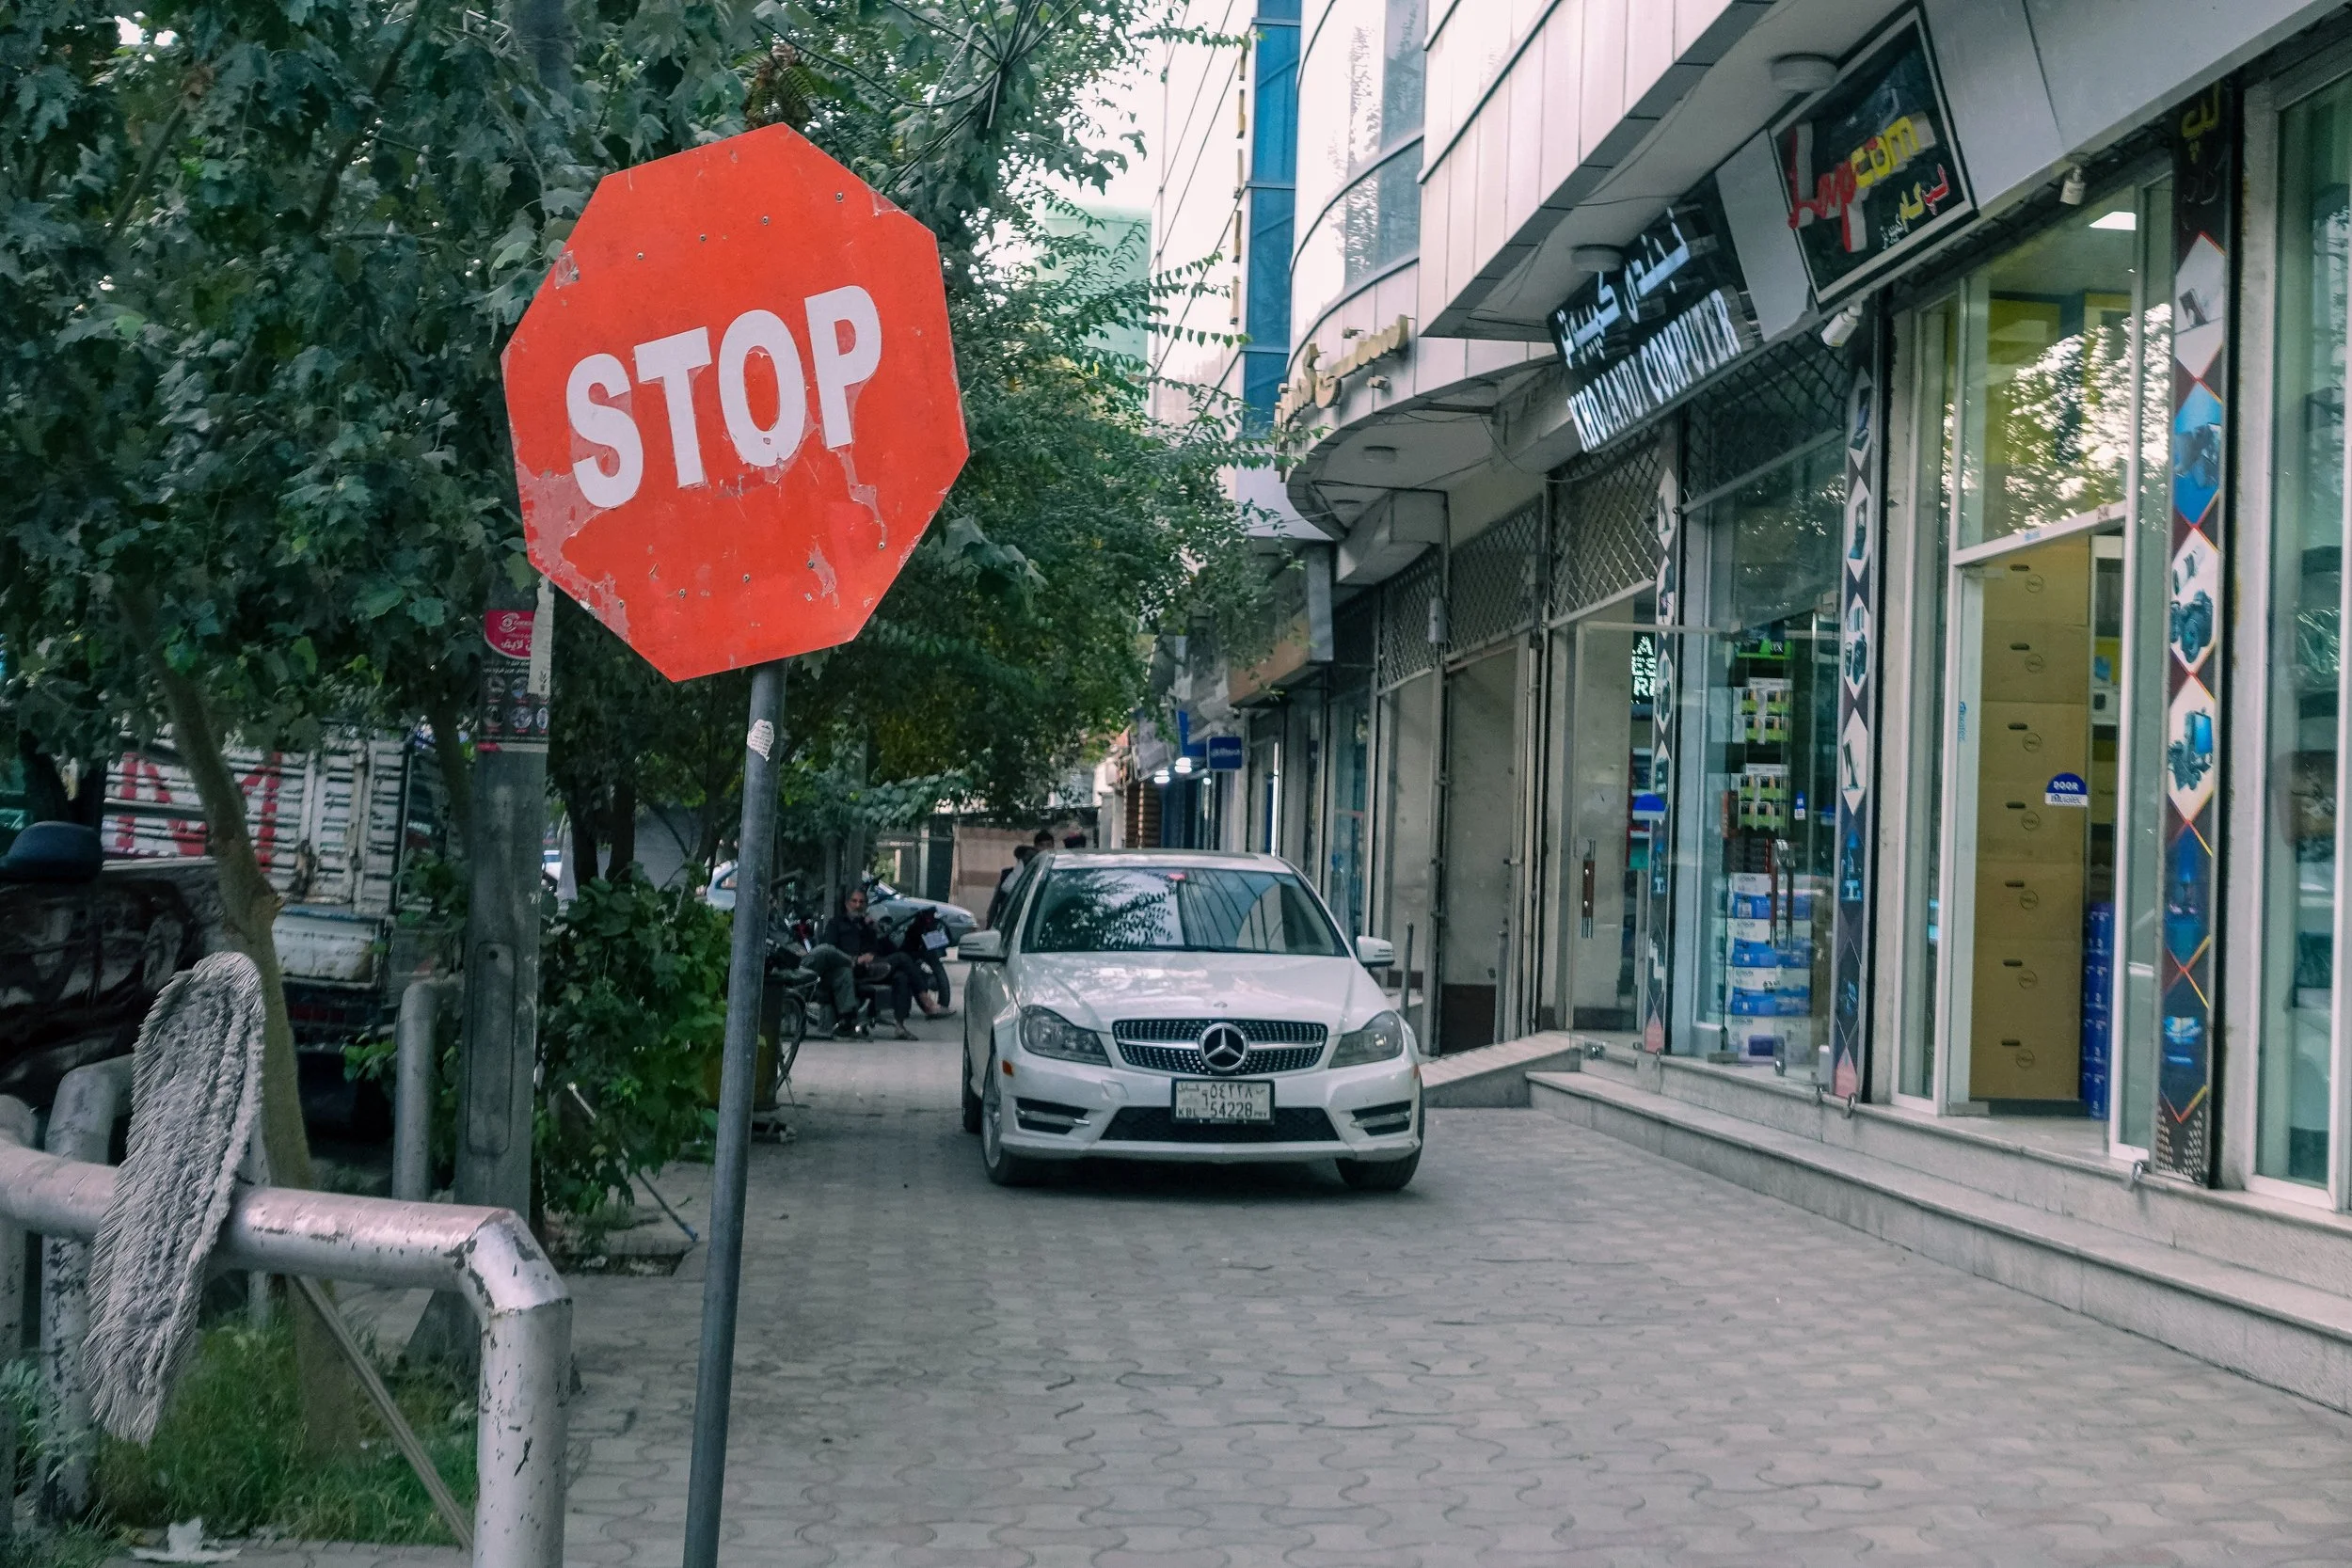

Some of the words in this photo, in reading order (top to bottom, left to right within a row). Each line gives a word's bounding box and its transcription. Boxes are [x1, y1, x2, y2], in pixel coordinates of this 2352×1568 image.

[565, 285, 882, 509] STOP
[1640, 289, 1740, 404] COMPUTER
[1210, 1101, 1252, 1117] 54228
